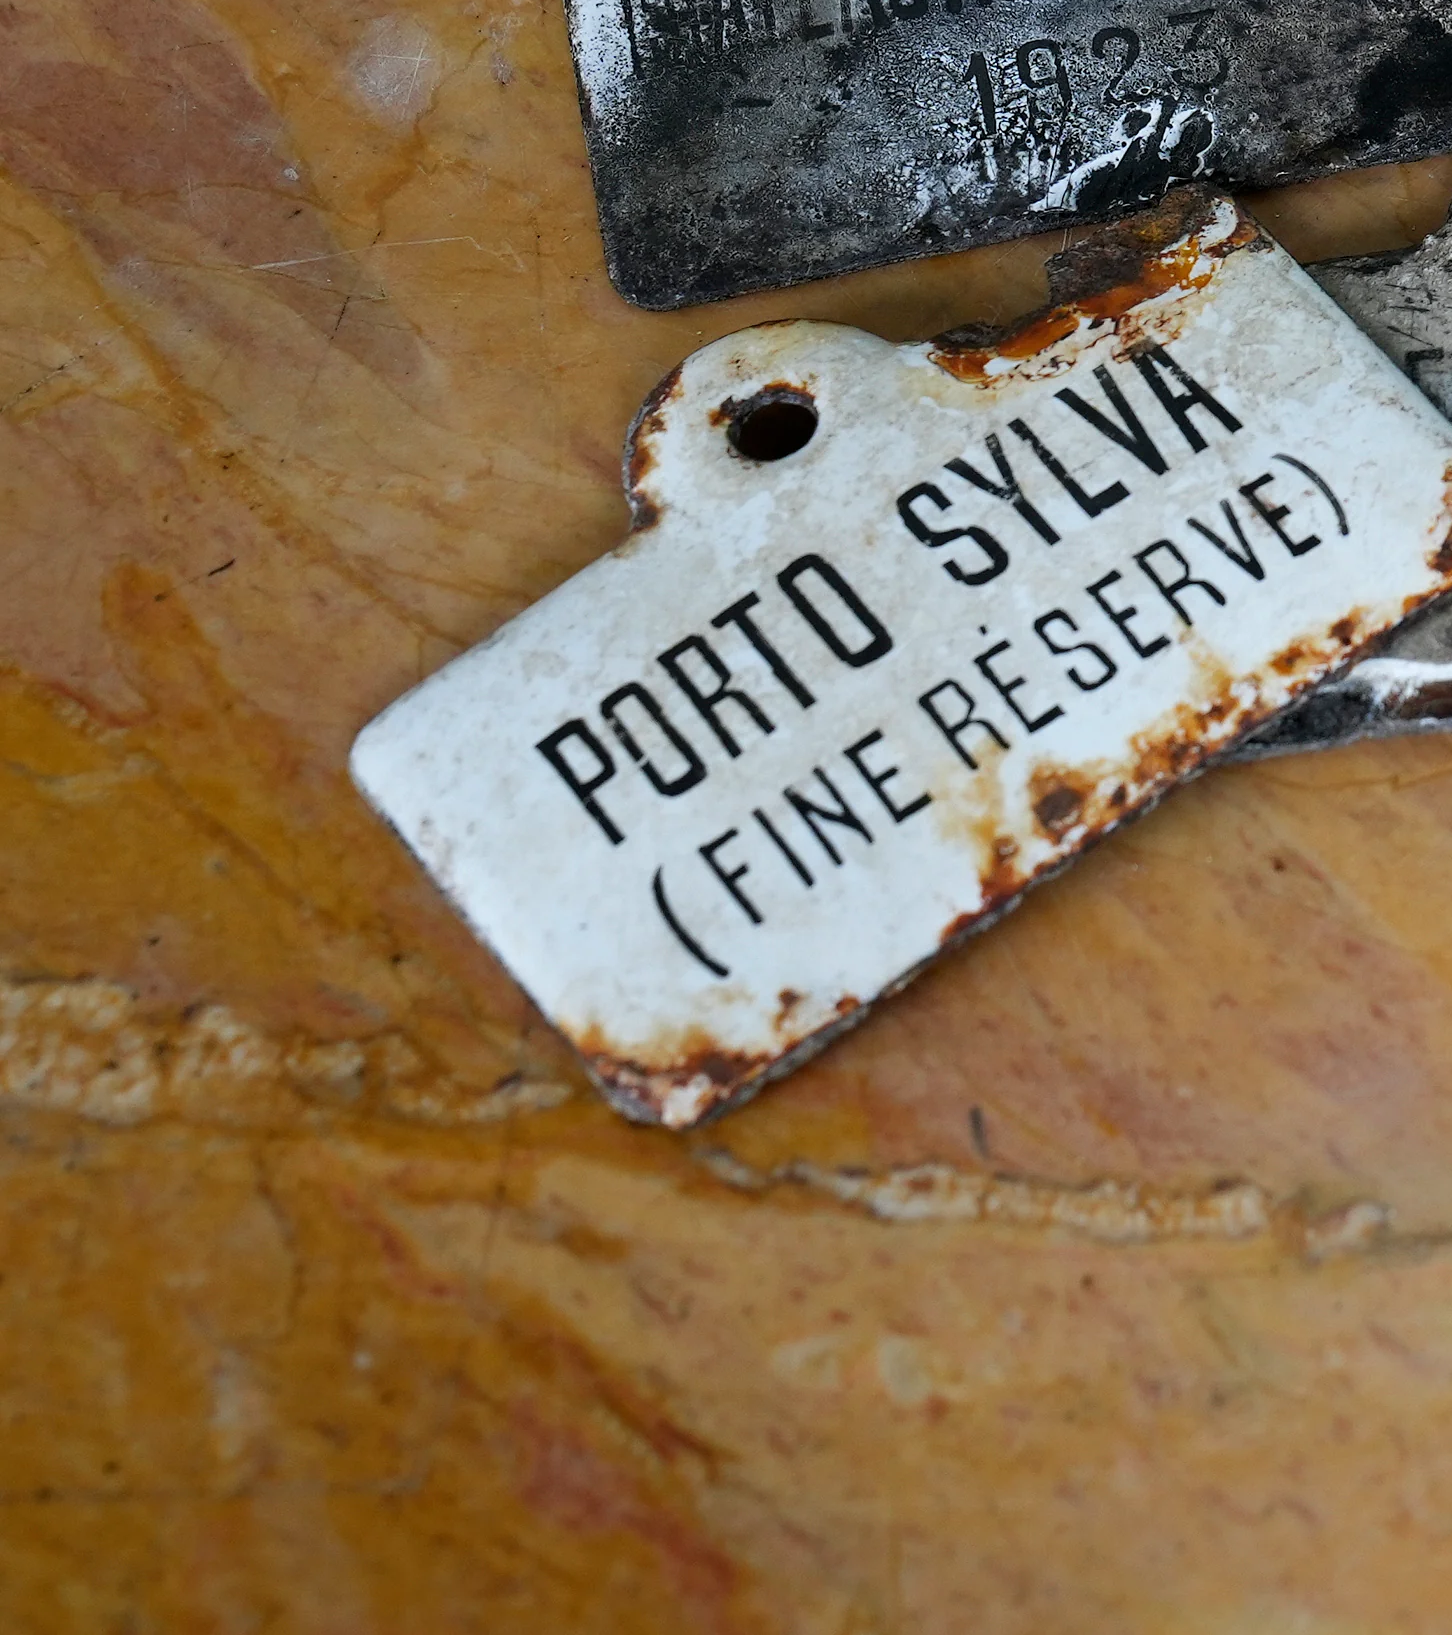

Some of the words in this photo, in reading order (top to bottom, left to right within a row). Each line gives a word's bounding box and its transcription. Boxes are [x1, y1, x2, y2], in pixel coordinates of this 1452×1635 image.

[534, 550, 895, 846] PORTO
[895, 341, 1244, 586] SYLVA
[650, 729, 934, 979] (FINE
